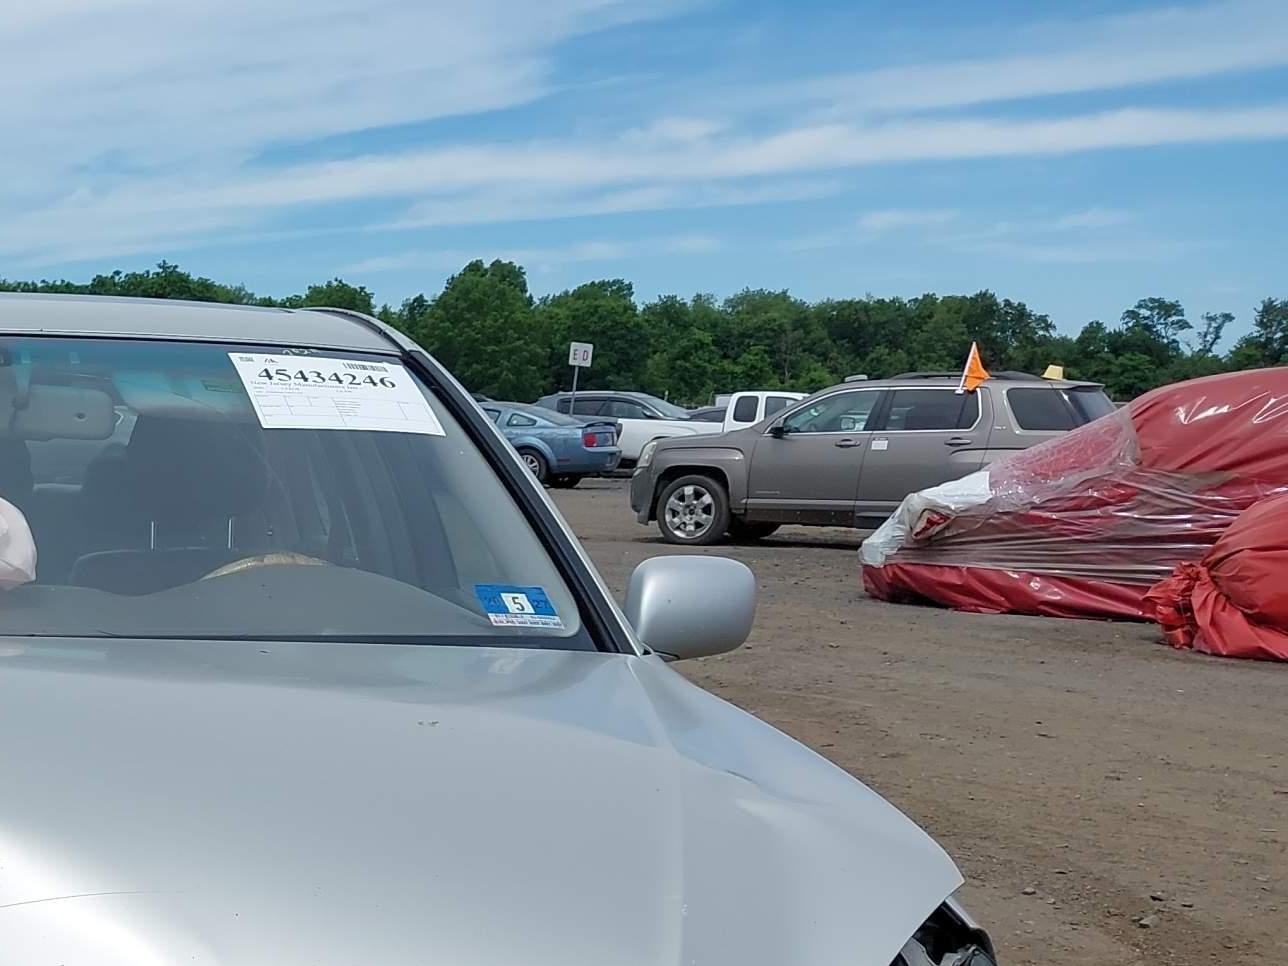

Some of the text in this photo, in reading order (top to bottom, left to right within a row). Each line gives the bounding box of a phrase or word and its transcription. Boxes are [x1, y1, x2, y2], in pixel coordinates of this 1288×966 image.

[573, 349, 579, 360] E
[258, 368, 396, 389] 45434246
[512, 596, 525, 611] 5
